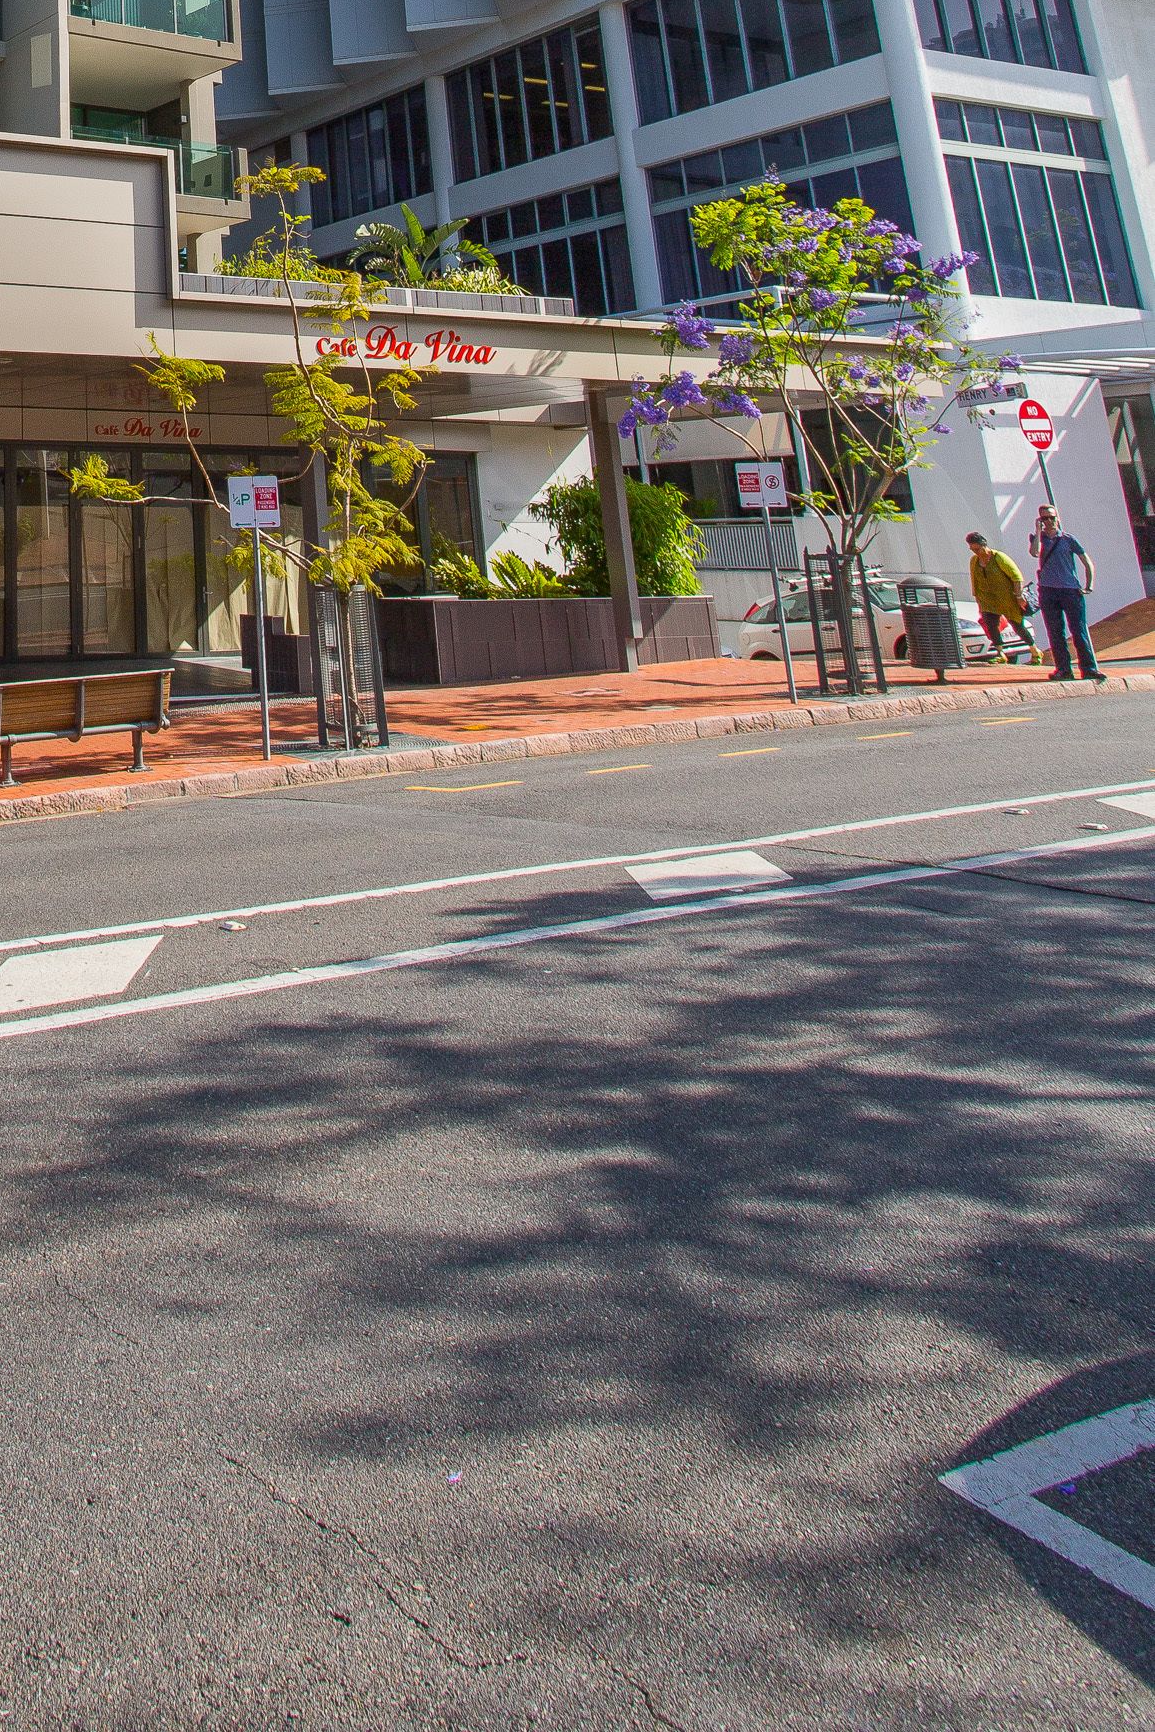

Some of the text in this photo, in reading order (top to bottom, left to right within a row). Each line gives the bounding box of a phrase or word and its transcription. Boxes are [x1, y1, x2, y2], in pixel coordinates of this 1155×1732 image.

[364, 325, 418, 361] Da
[425, 329, 498, 365] Vina
[959, 388, 987, 401] HENRY
[1026, 406, 1038, 416] NO
[94, 417, 203, 438] Café Da Vina
[1026, 432, 1051, 443] ENTRY
